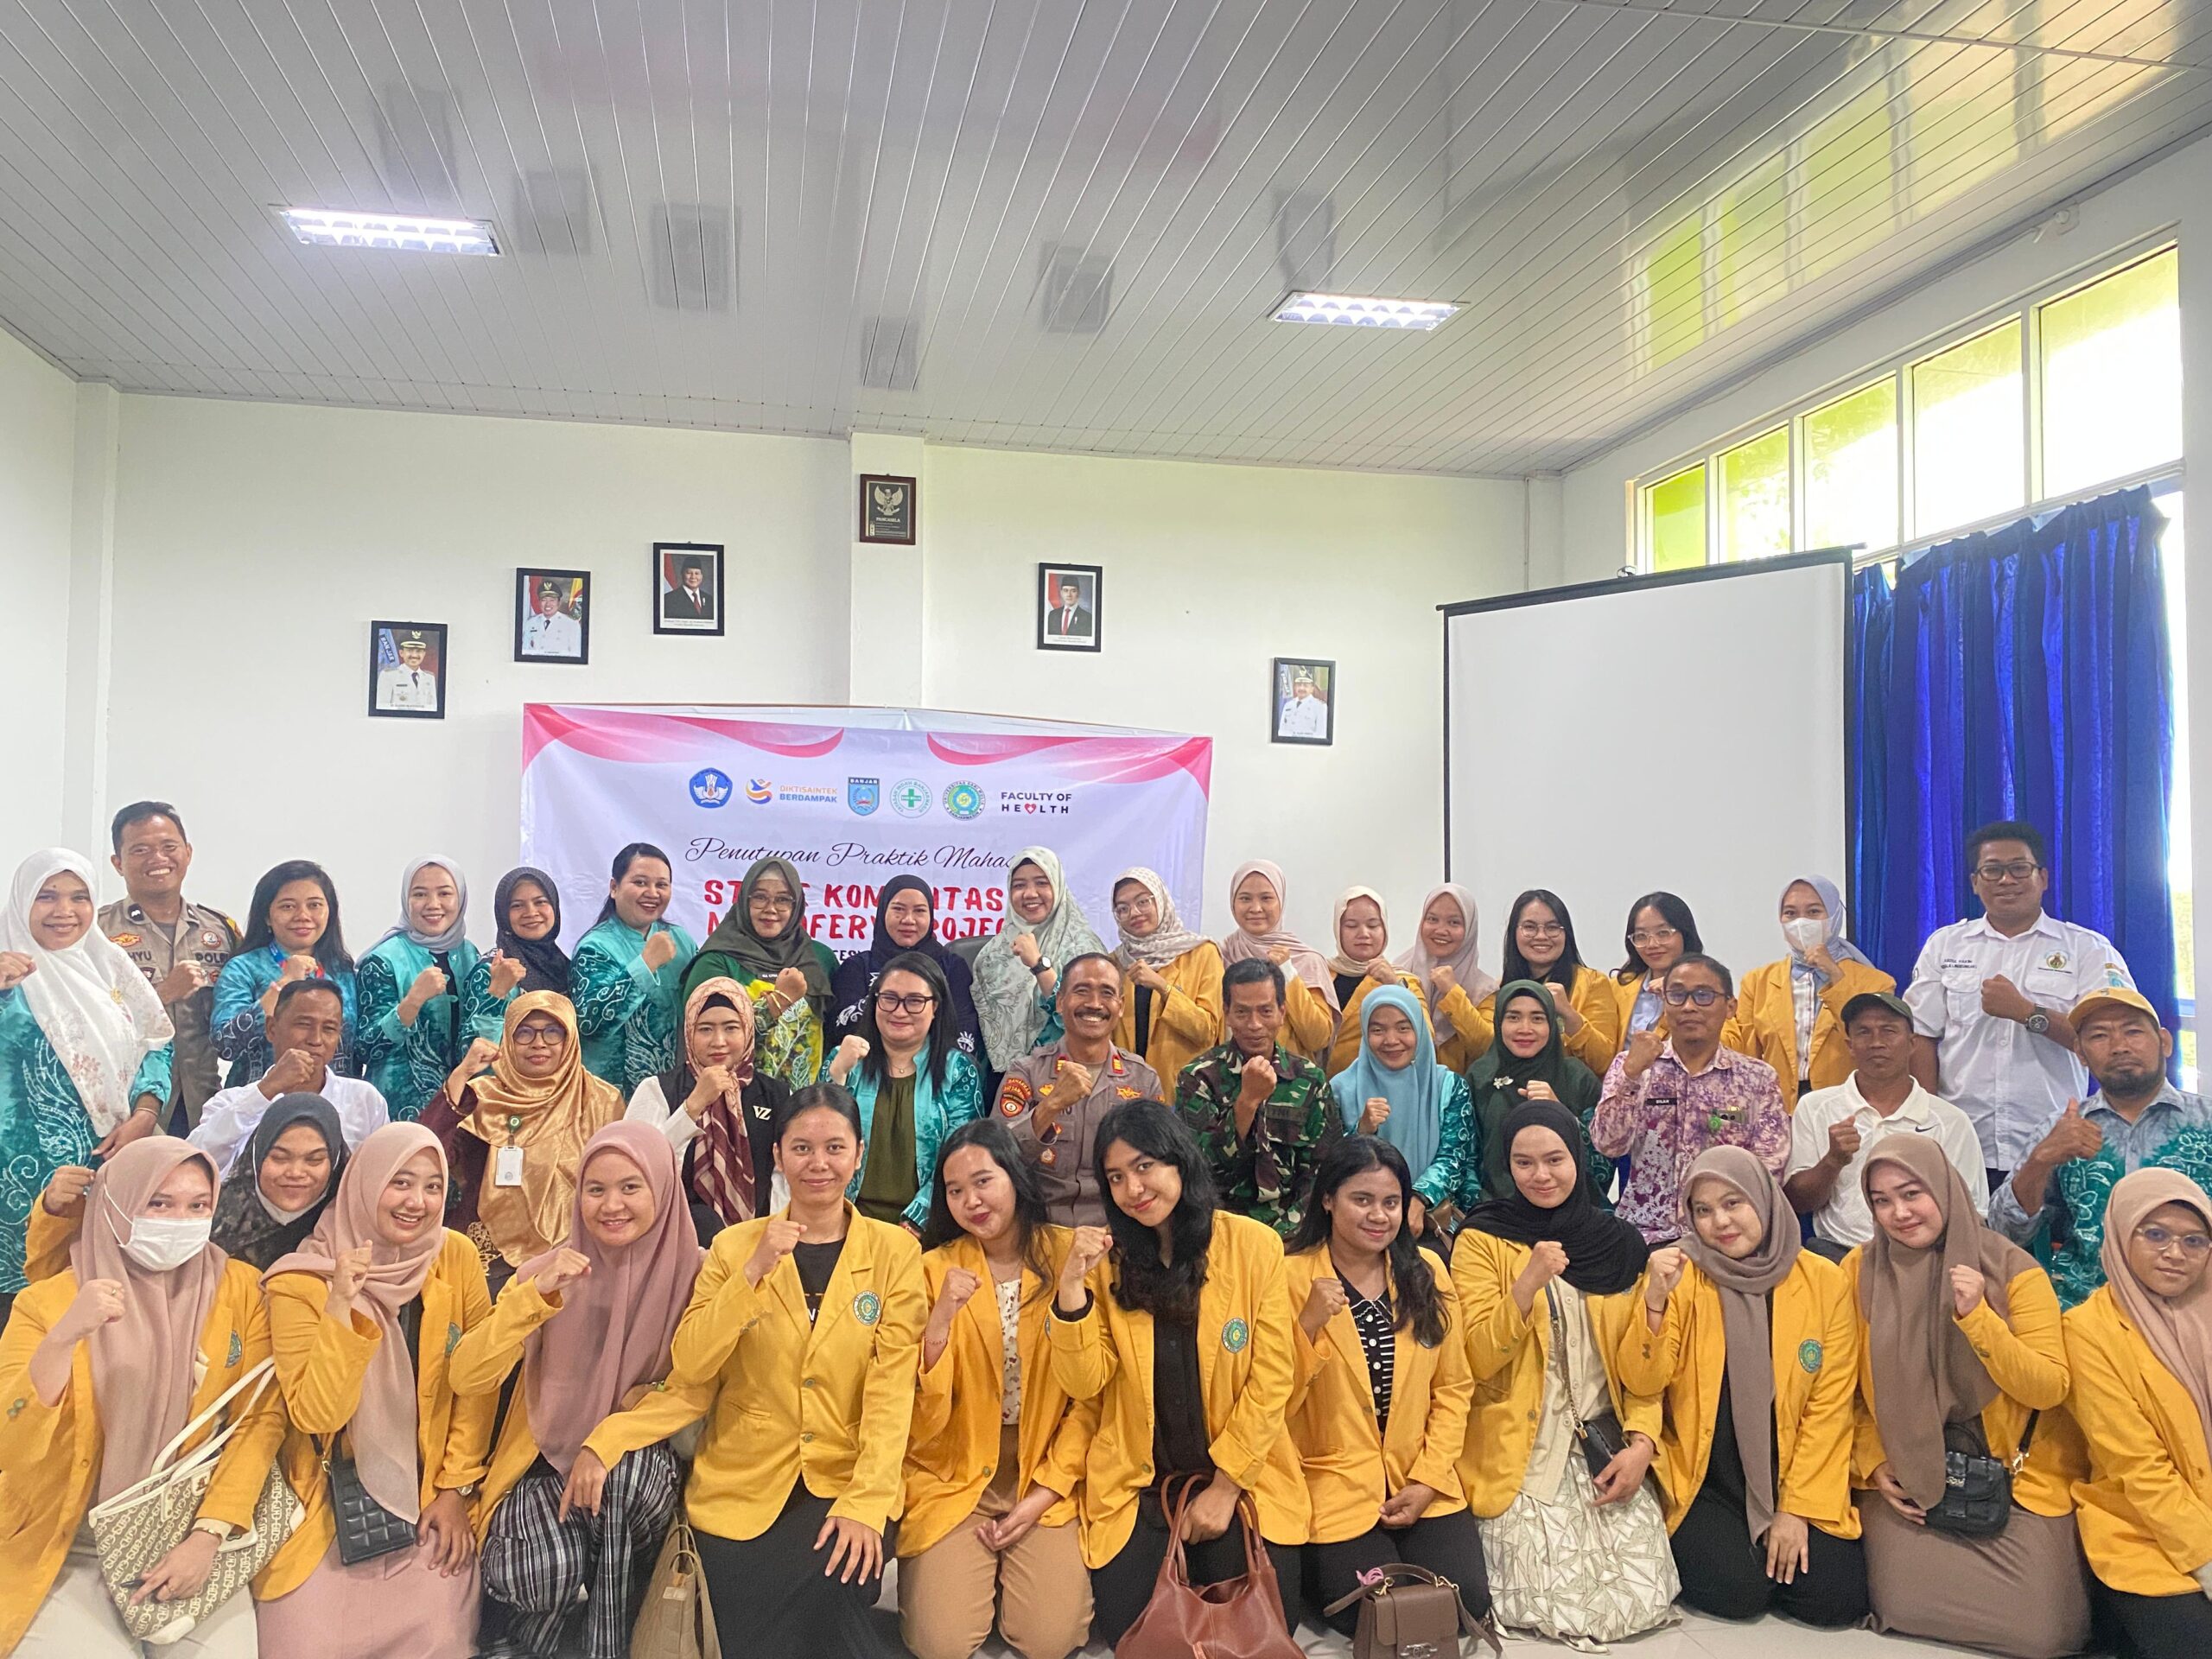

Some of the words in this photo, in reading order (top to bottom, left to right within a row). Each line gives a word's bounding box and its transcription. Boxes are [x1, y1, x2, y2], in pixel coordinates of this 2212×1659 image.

[779, 785, 837, 794] DIKTISAINTEK
[779, 793, 837, 803] BERDAMPAK
[1001, 791, 1052, 802] FACULTY
[1057, 792, 1072, 802] OF
[826, 842, 929, 867] Praktik
[130, 951, 152, 962] HYU
